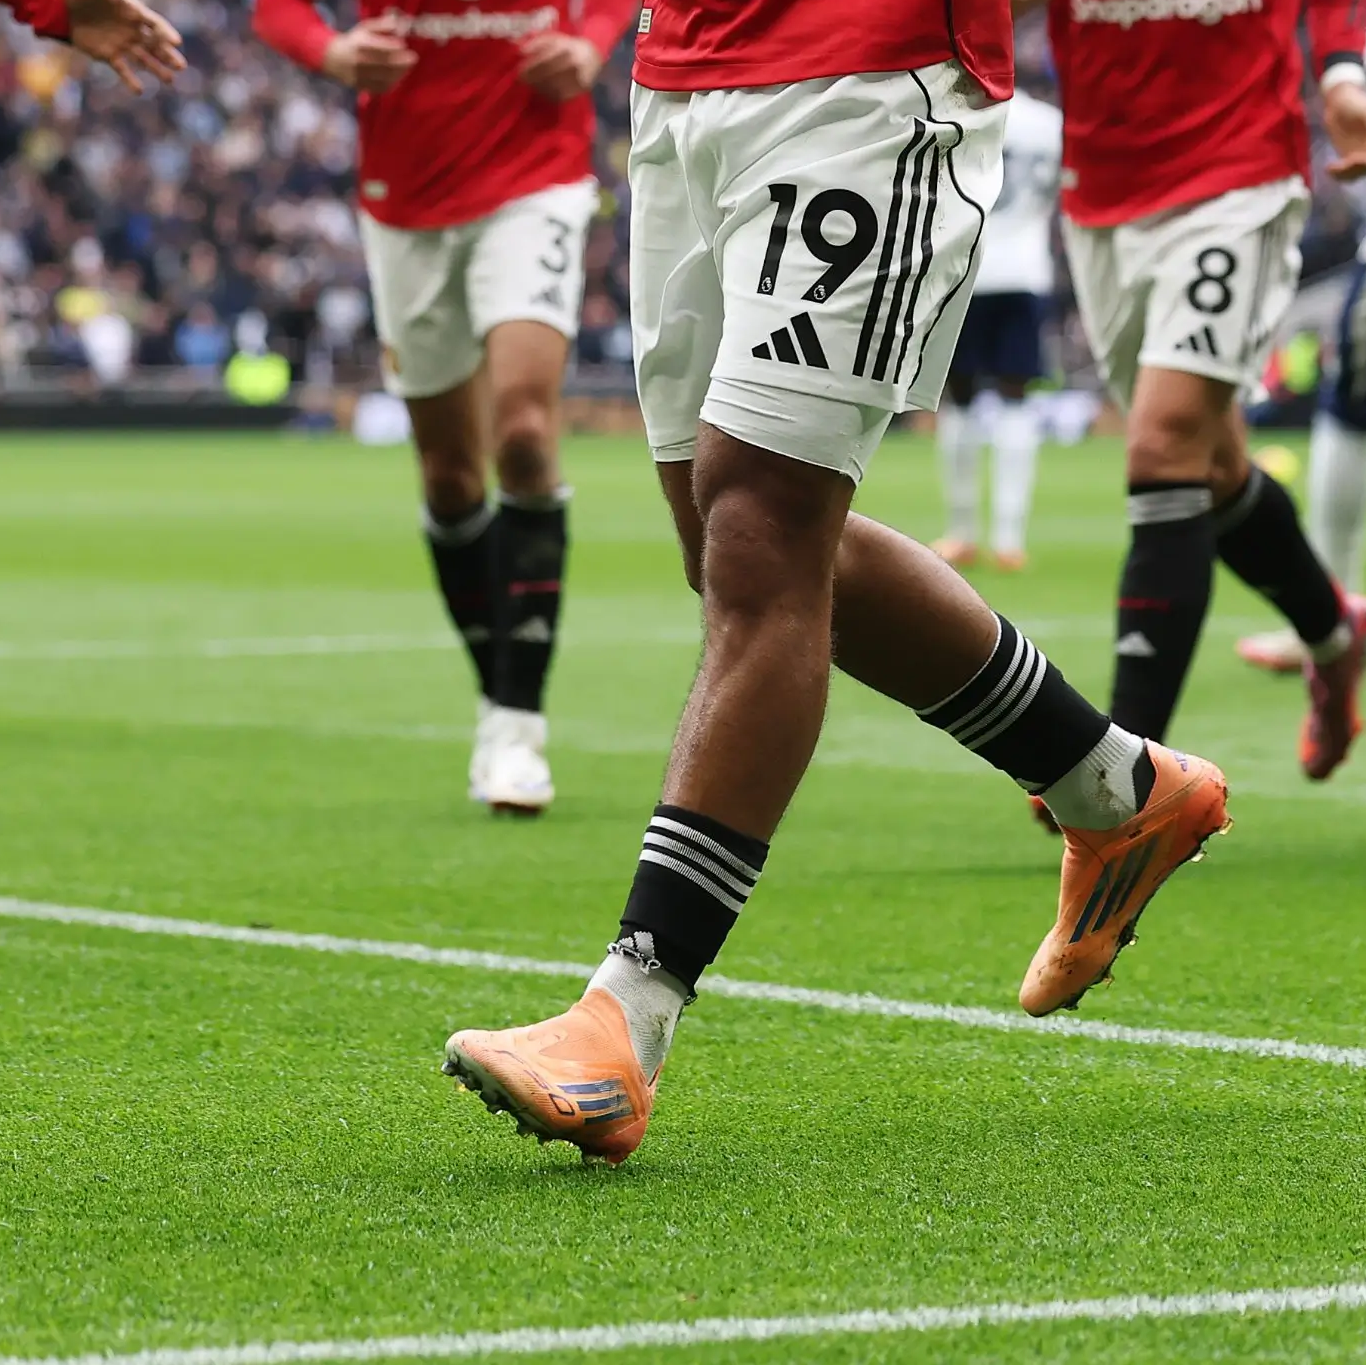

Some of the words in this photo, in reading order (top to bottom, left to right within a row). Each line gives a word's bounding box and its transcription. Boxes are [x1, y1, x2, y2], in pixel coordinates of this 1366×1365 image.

[539, 217, 572, 274] 3
[757, 183, 878, 304] 19
[1187, 247, 1236, 314] 8
